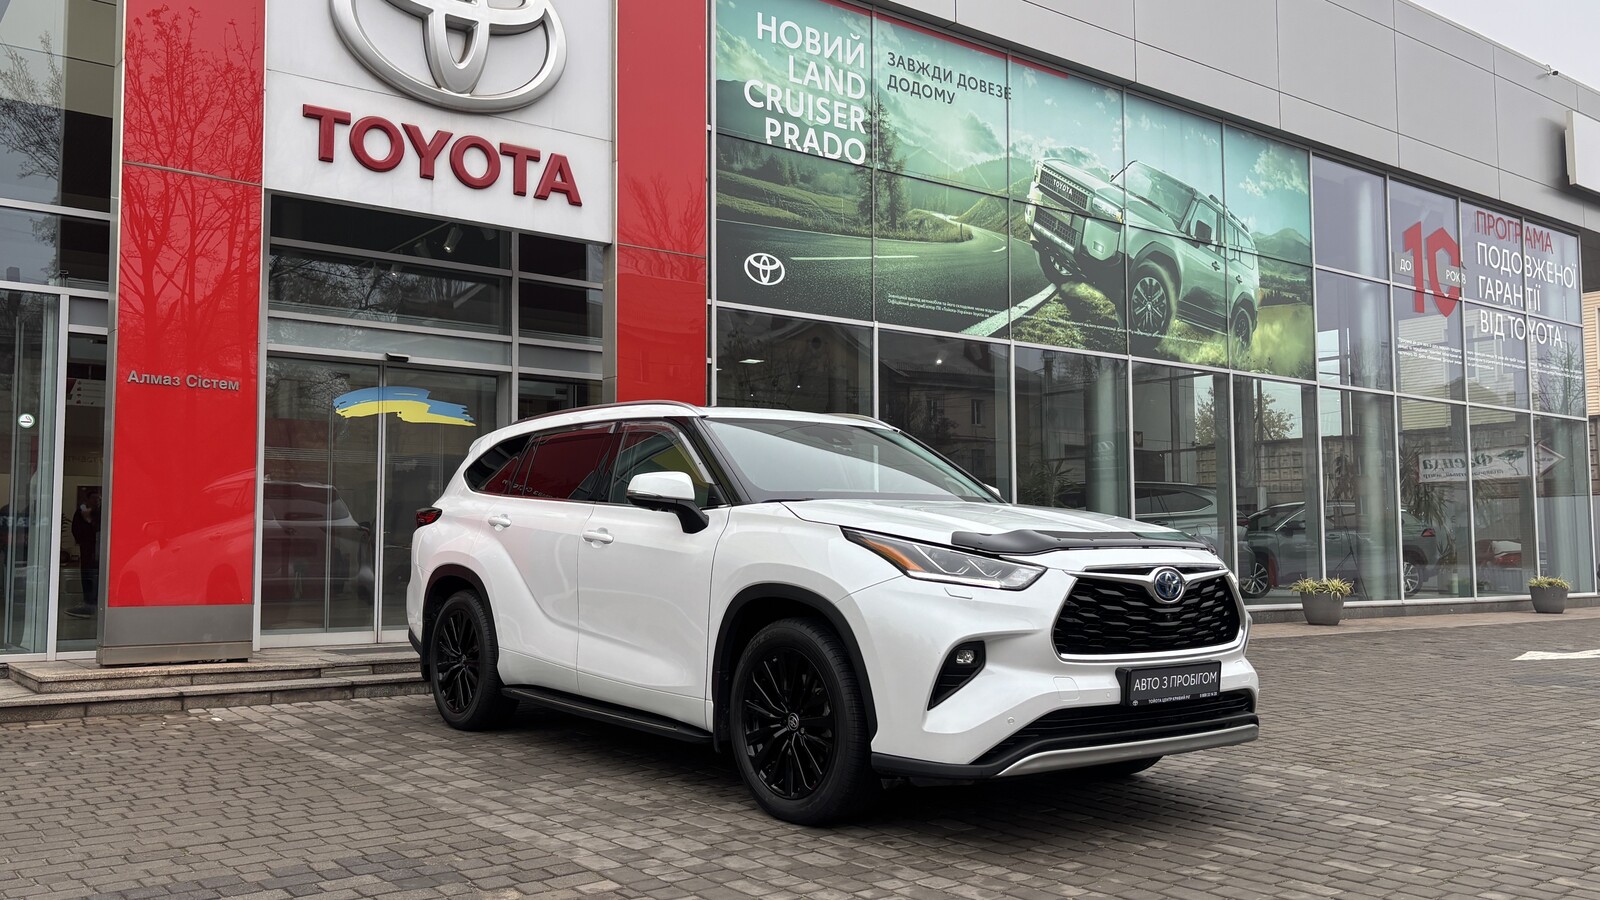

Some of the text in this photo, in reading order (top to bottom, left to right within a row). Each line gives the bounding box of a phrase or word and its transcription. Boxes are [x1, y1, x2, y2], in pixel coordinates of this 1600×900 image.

[757, 11, 865, 69] НОВИЙ
[788, 55, 866, 100] LAND
[887, 52, 1012, 101] ЗАВЖДИ ДОВЕЗЕ
[887, 74, 956, 105] ДОДОМУ
[744, 79, 866, 135] CRUISER
[302, 103, 583, 207] TOYOTA
[765, 117, 866, 166] PRADO
[1053, 179, 1073, 196] TOYOTA
[1476, 210, 1554, 255] ПРОГРАМА
[1400, 259, 1412, 272] ДО
[1477, 241, 1577, 290] ПОДОВЖЕНОЇ
[1478, 275, 1542, 312] ГАРАНТІЇ
[1480, 309, 1563, 349] ВІД TOYOTA
[127, 370, 240, 391] Алмаз Сістем
[1133, 671, 1218, 692] АВТО З ПРОБІГОМ
